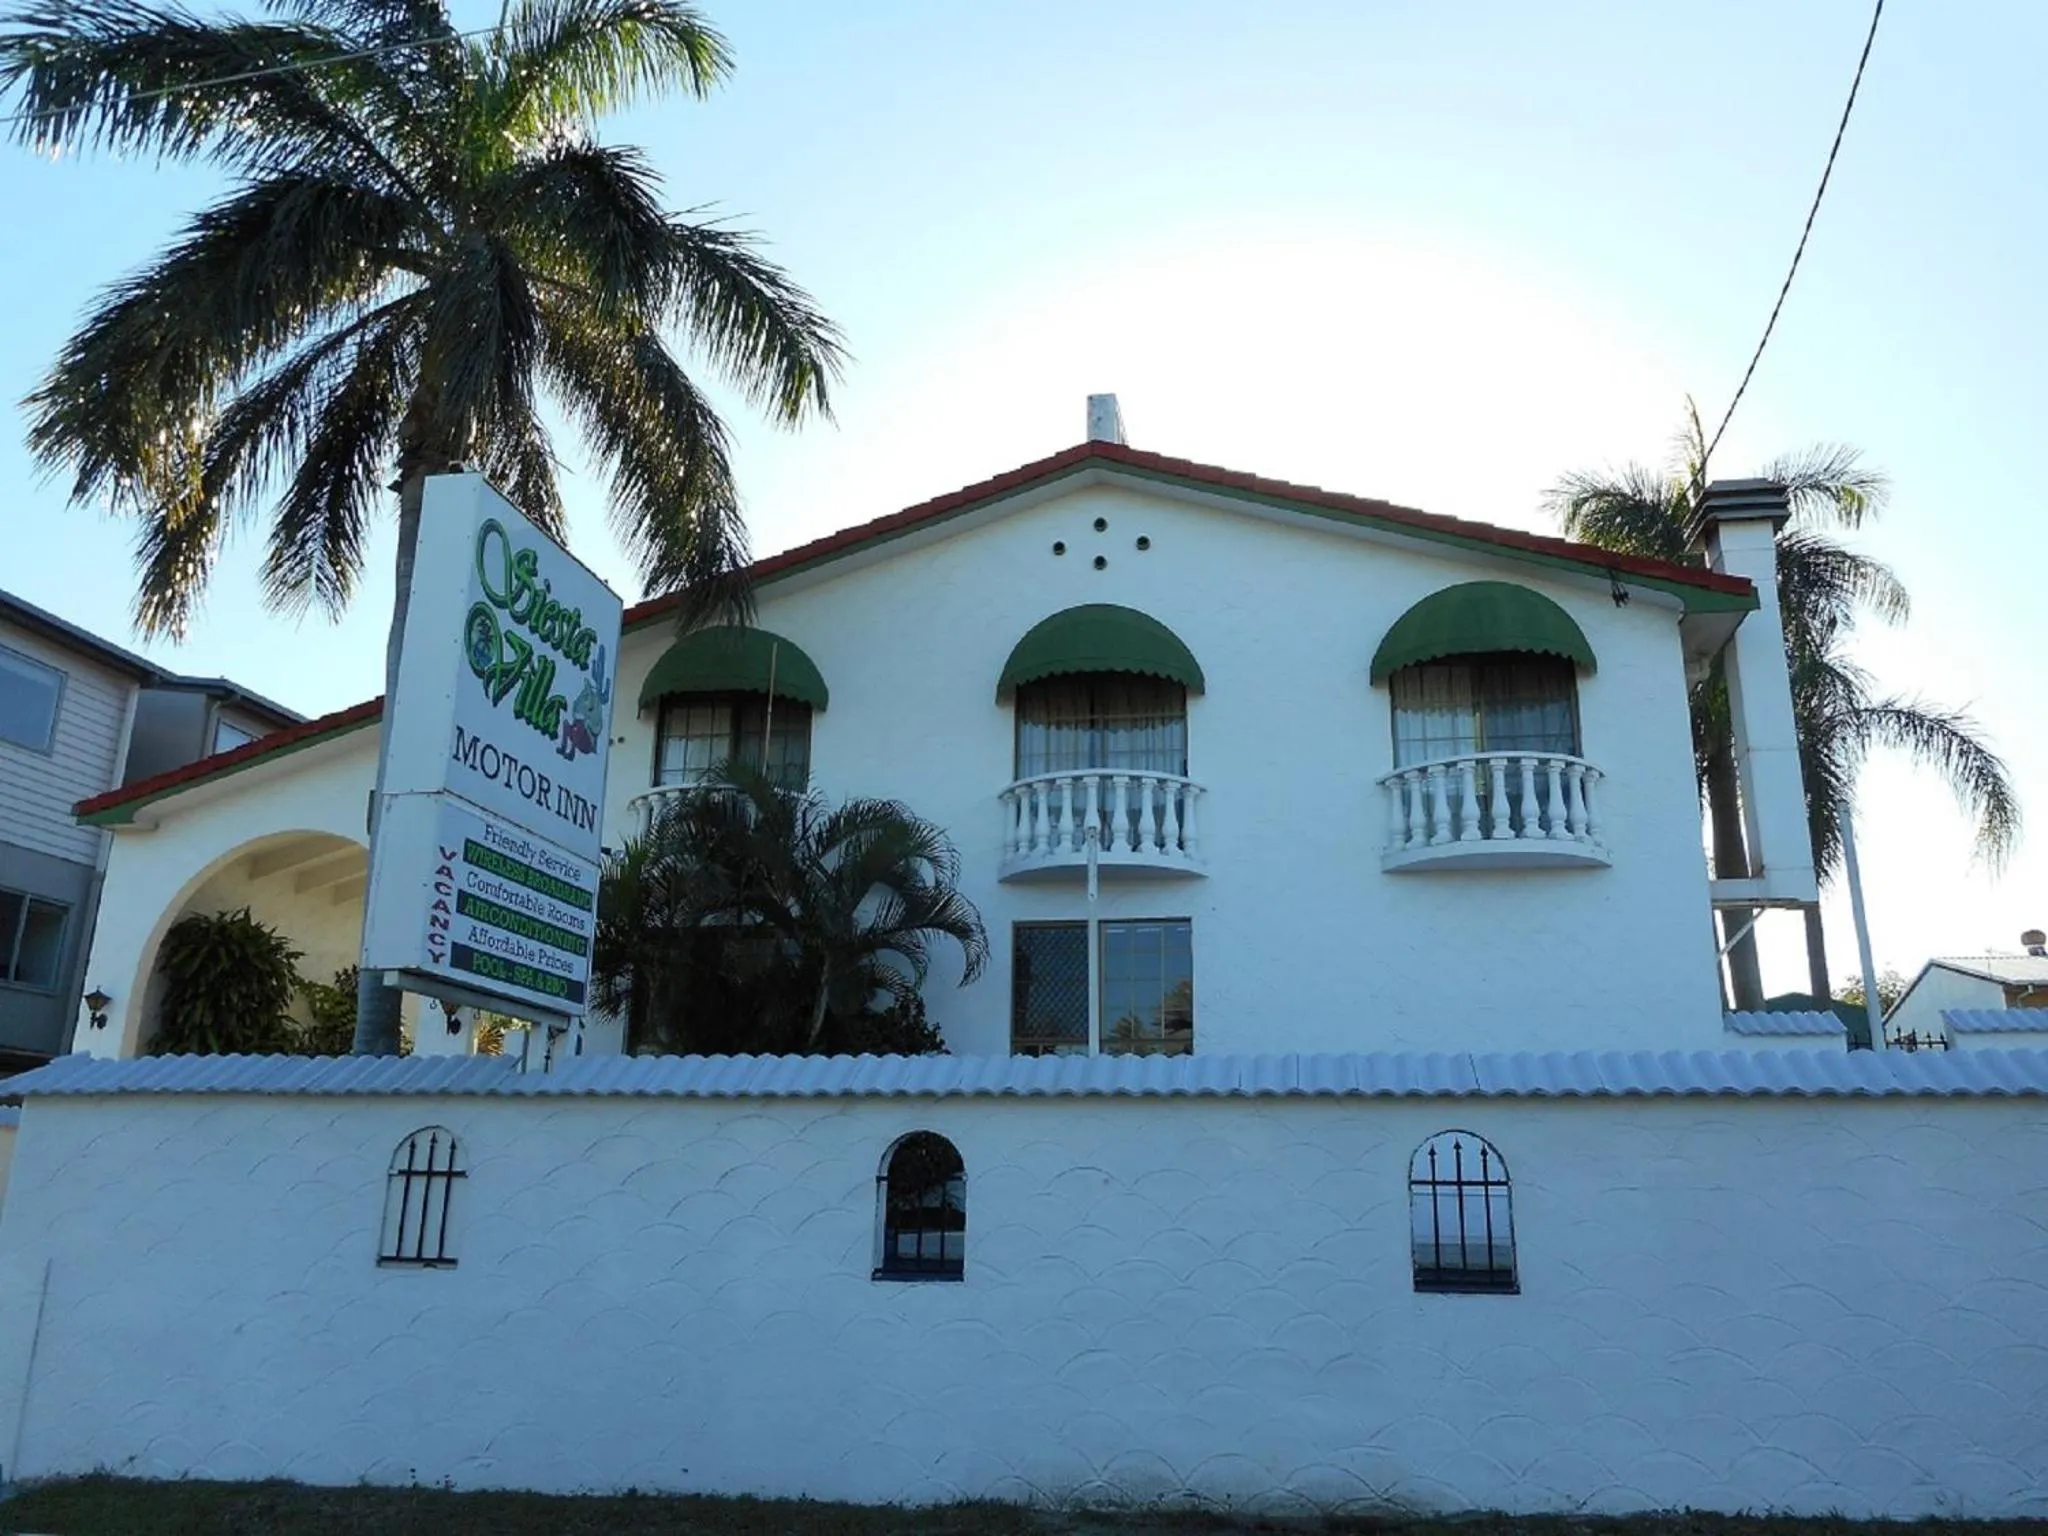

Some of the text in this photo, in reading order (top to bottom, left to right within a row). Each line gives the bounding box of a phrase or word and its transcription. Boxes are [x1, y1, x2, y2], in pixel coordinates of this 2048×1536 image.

[476, 518, 598, 671] Siesta
[464, 601, 568, 740] Villa
[452, 725, 598, 834] MOTOR INN
[428, 845, 457, 964] VACANCY
[466, 871, 585, 930] Comfortable Rooms
[483, 823, 581, 881] Friendly Service
[468, 925, 575, 974] Affordable Prices
